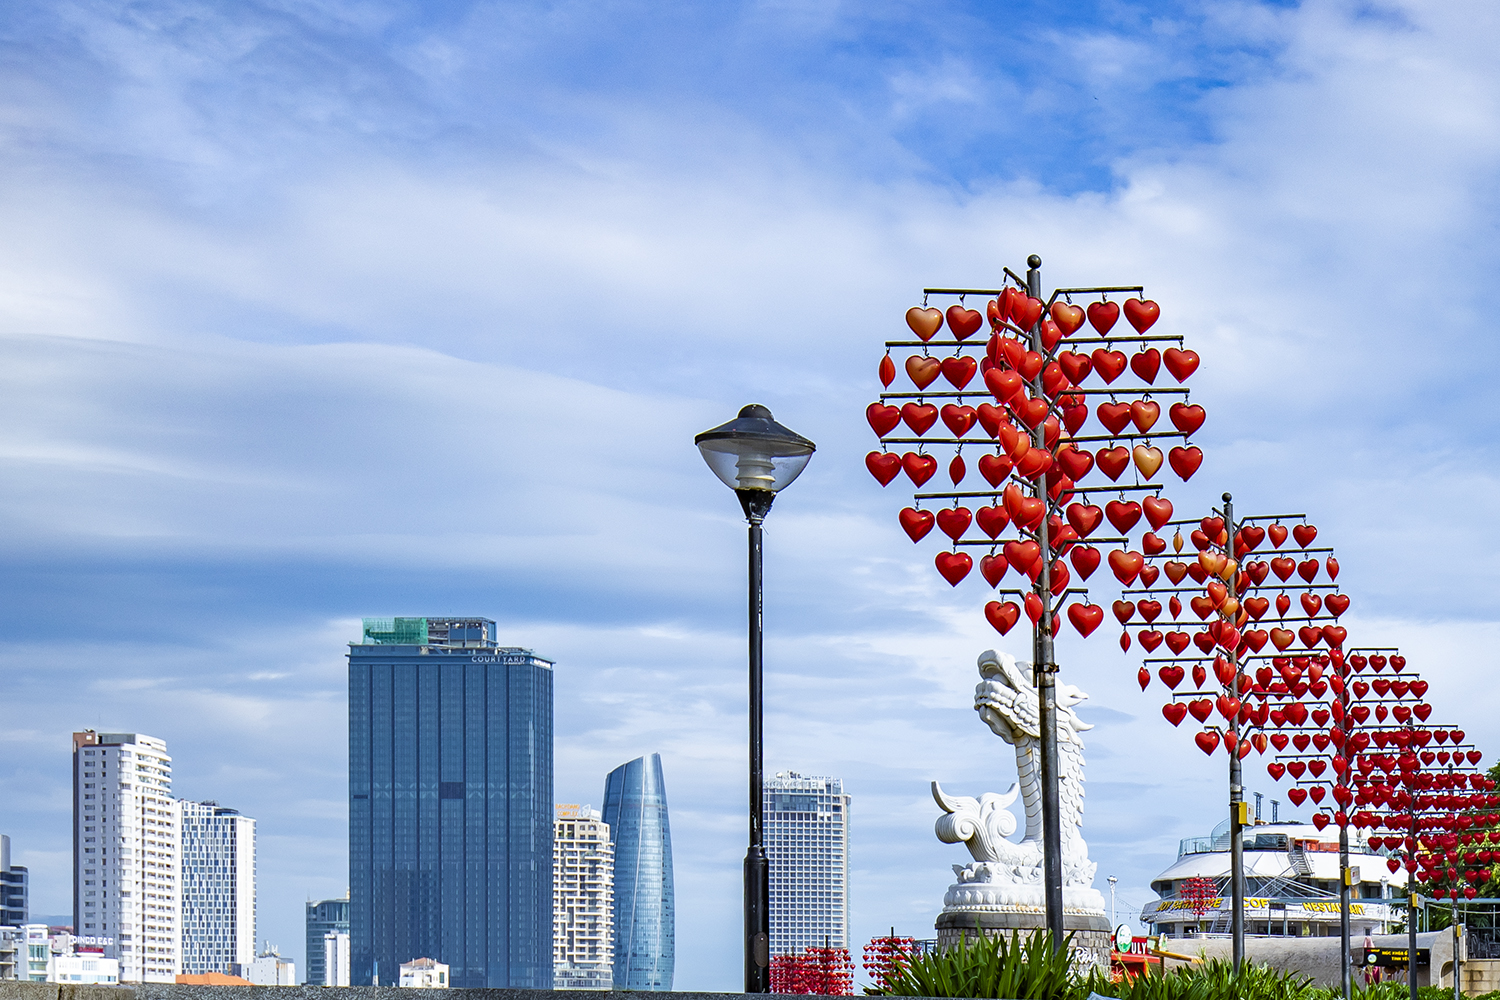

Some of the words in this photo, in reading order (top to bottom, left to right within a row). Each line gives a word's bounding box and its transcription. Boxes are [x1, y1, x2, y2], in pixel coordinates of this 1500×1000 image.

[471, 655, 526, 663] COURTYARD
[1243, 897, 1270, 908] COF
[72, 936, 96, 945] DINCO
[97, 937, 114, 946] E&C
